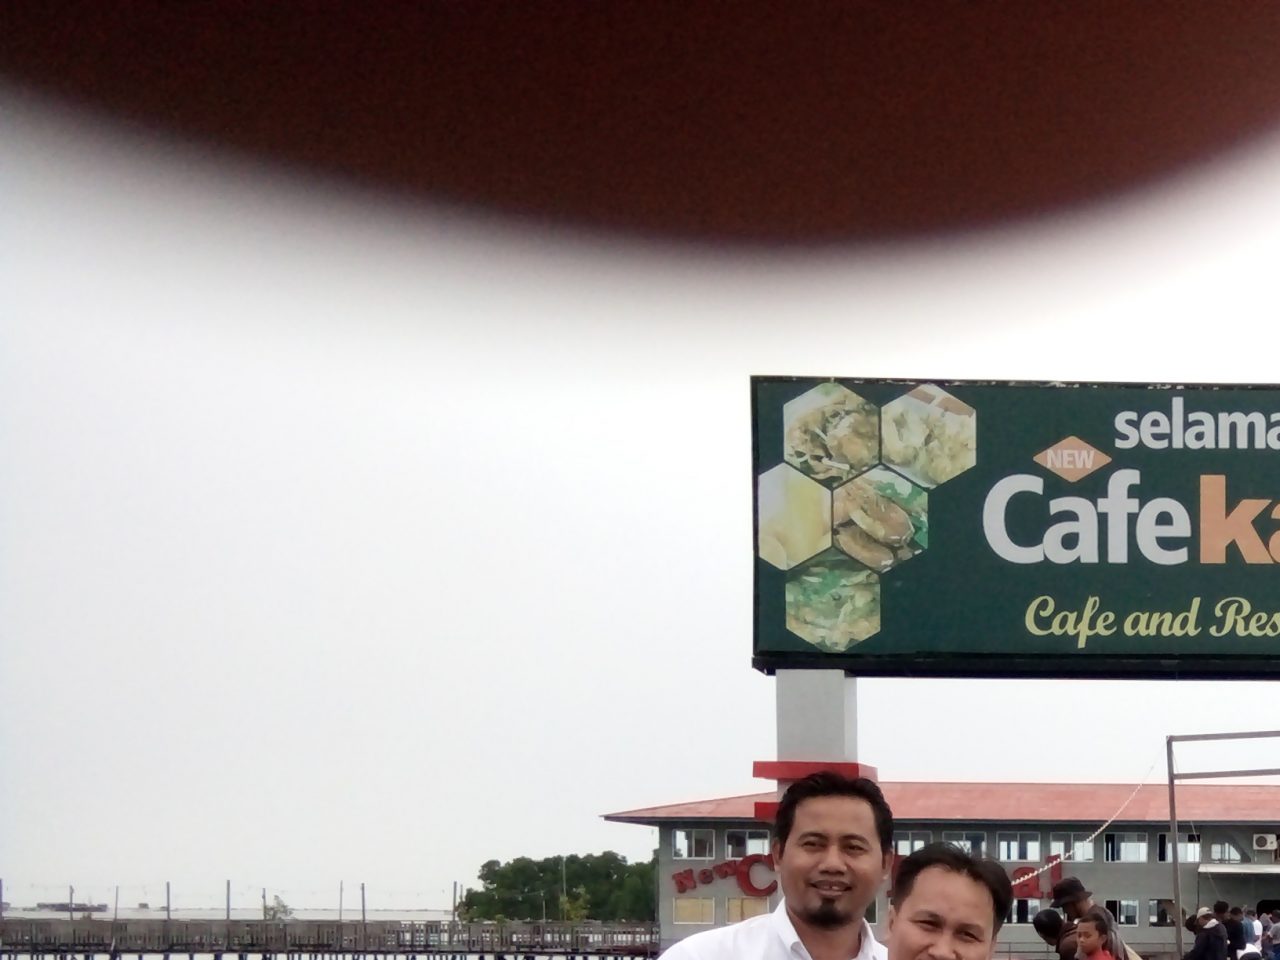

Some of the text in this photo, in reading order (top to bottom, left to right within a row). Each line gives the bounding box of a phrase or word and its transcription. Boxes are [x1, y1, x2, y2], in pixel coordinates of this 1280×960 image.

[1046, 449, 1095, 469] NEW
[982, 468, 1192, 566] Cafe
[1024, 594, 1118, 649] Cafe
[1123, 596, 1202, 637] and
